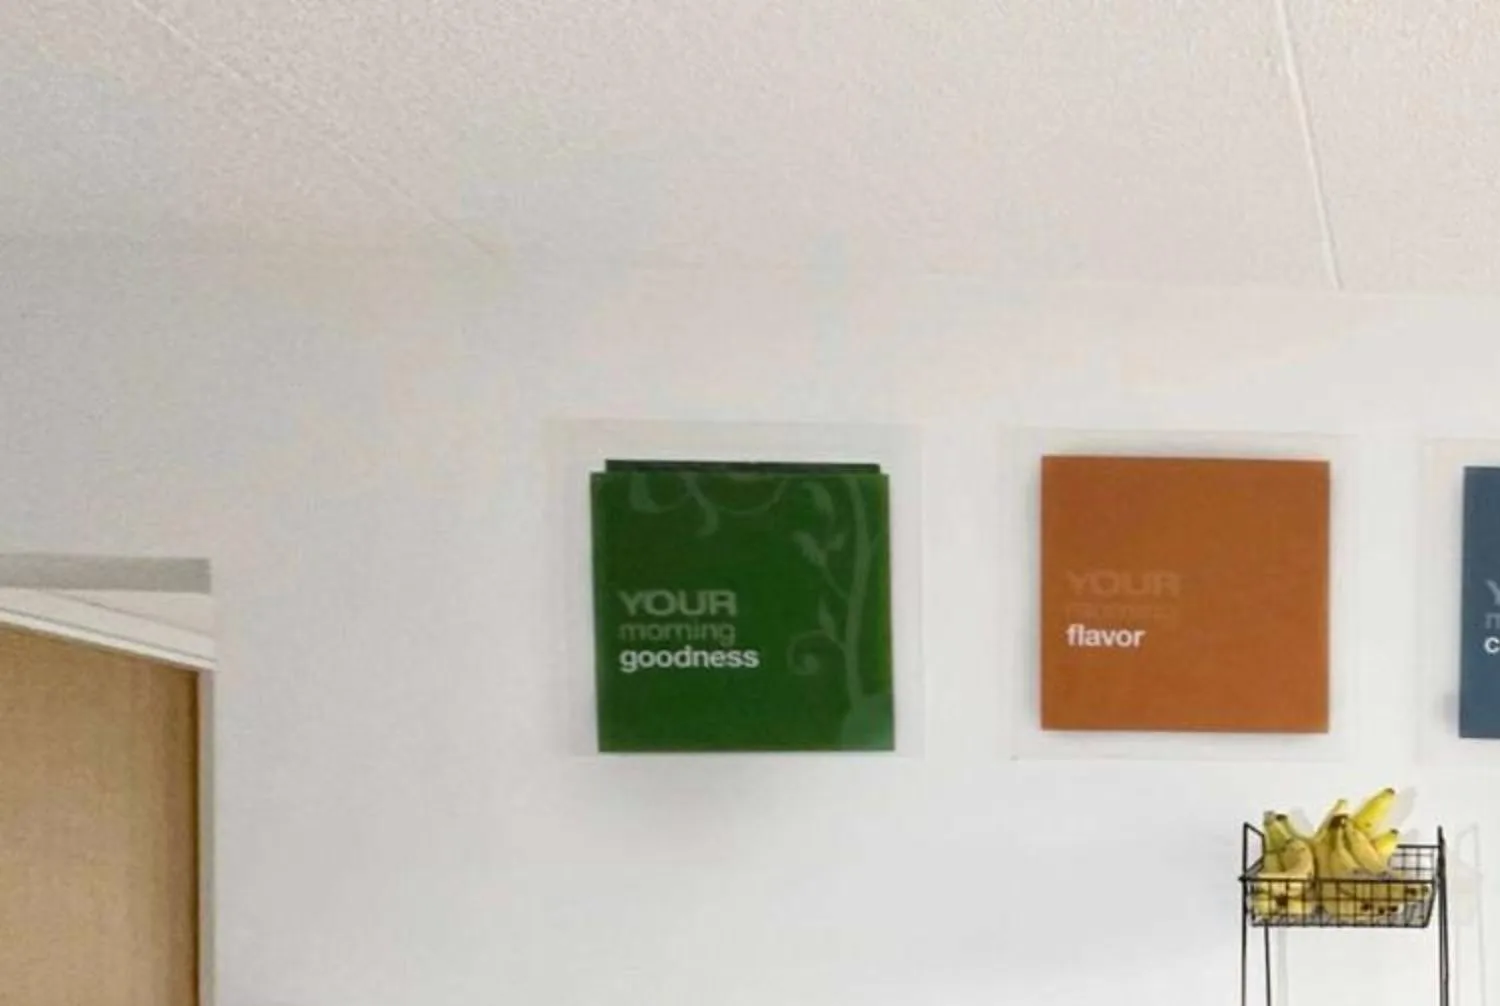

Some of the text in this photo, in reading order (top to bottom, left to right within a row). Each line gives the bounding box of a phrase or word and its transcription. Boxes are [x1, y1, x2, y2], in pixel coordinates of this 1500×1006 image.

[1067, 569, 1180, 598] YOUR
[618, 590, 737, 616] YOUR
[618, 618, 736, 646] morning
[1066, 623, 1146, 647] flavor
[619, 645, 760, 673] goodness
